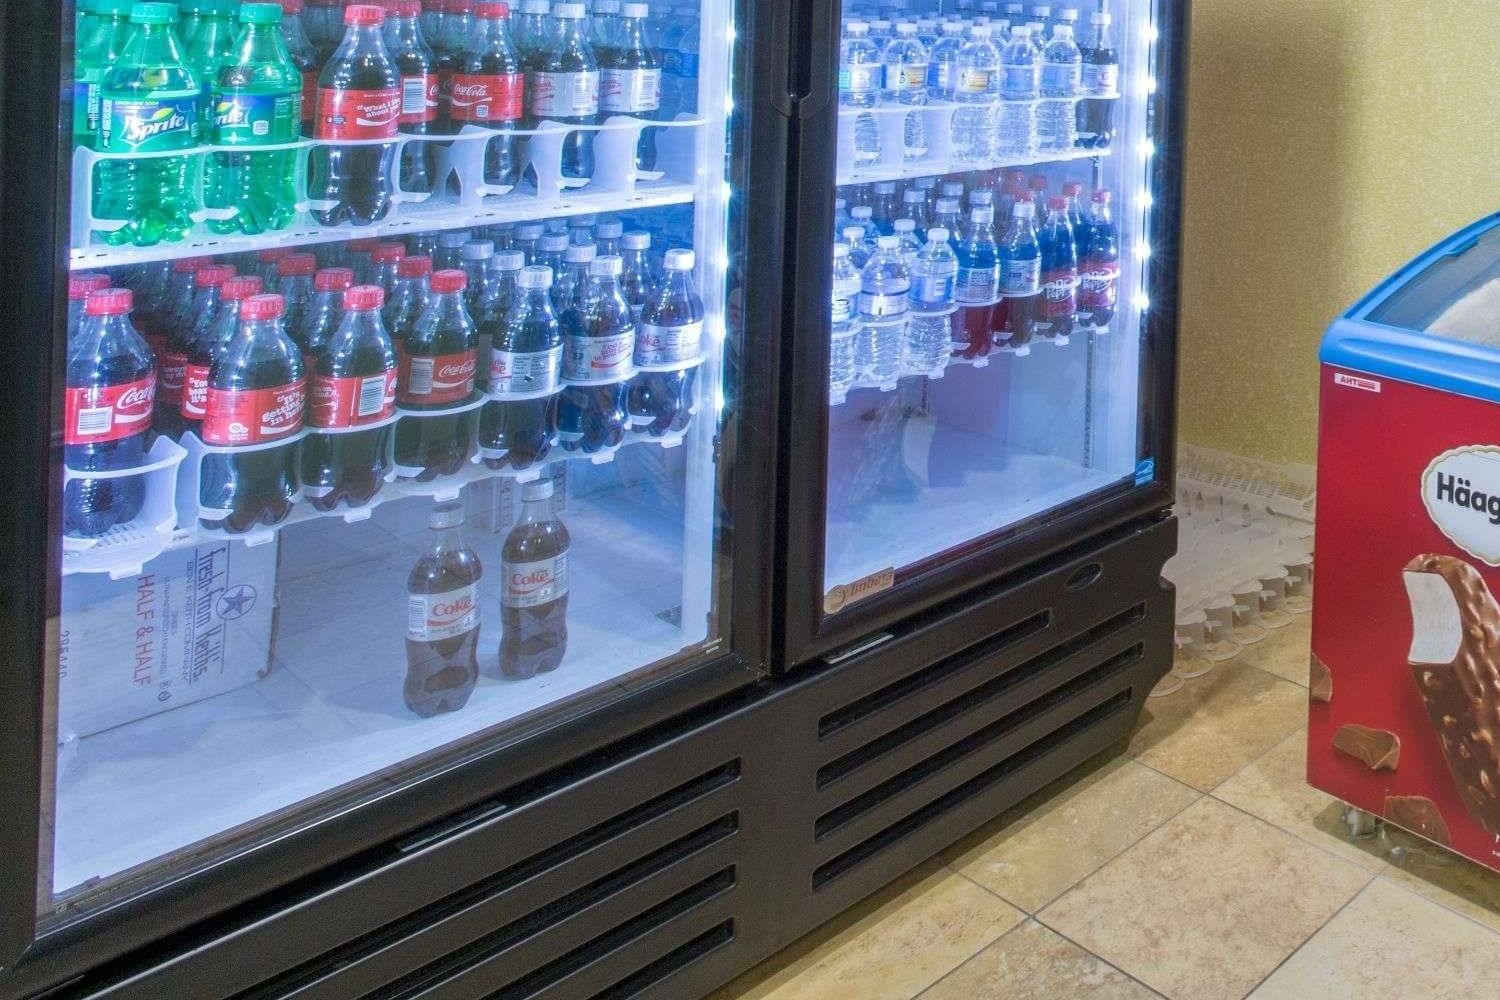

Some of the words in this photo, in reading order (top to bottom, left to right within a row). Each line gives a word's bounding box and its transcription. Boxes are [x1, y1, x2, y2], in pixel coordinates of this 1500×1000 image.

[126, 113, 185, 141] Sprite
[136, 574, 155, 619] HALF
[135, 626, 154, 641] &
[132, 642, 154, 688] HALF
